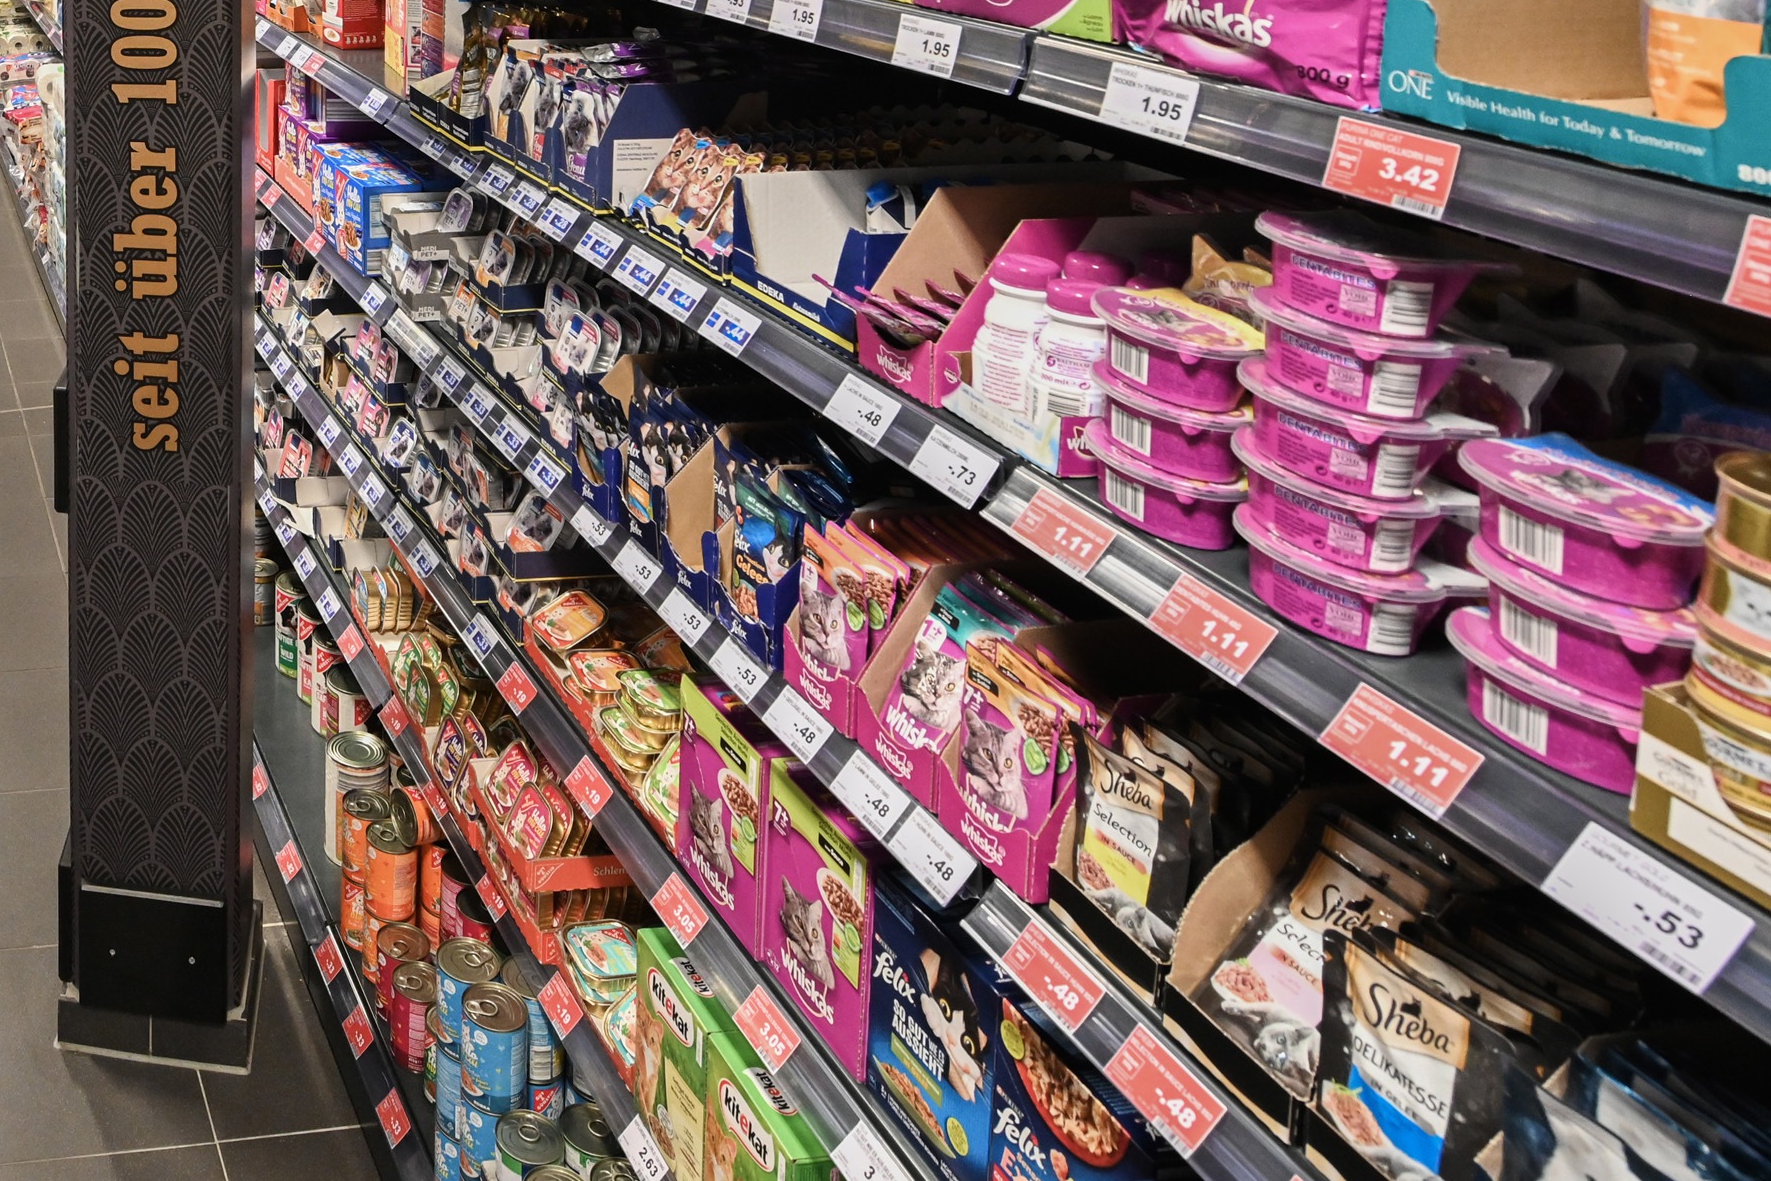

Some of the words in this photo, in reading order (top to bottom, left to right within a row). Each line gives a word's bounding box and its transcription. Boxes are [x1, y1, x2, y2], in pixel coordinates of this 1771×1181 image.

[792, 7, 815, 25] 1.95
[922, 39, 951, 58] 1.95
[1388, 68, 1433, 100] ONE
[1141, 95, 1183, 121] 1.95
[1447, 89, 1488, 113] Visible
[1490, 99, 1536, 123] Health
[1540, 111, 1560, 128] for
[1563, 116, 1606, 140] Today
[1609, 126, 1622, 141] &
[1625, 129, 1707, 158] Tomorrow
[1378, 156, 1440, 192] 3.42
[113, 140, 179, 299] über
[1291, 252, 1377, 290] DENTABITES
[757, 280, 785, 304] EDEKA
[876, 356, 912, 382] whiskas
[1281, 331, 1364, 370] DENTABITES
[113, 331, 180, 453] seit
[857, 407, 883, 428] -.48
[948, 461, 977, 486] -.73
[1054, 526, 1092, 558] 1.11
[1200, 619, 1249, 659] 1.11
[736, 665, 758, 687] -.53
[793, 720, 817, 745] -.48
[1389, 740, 1450, 788] 1.11
[865, 791, 890, 818] -.48
[1100, 759, 1153, 811] Sheba
[961, 815, 1005, 866] whiskas
[1093, 803, 1153, 858] Selection
[690, 846, 736, 911] whiskas
[926, 853, 954, 881] -.48
[673, 904, 695, 934] 3.05
[1631, 899, 1707, 952] -.53
[781, 946, 835, 1025] whiskas
[873, 950, 916, 1006] felix
[1043, 974, 1079, 1011] -.48
[651, 973, 690, 1040] kitekat
[893, 1000, 906, 1023] SO
[908, 1016, 929, 1046] GUT
[1364, 982, 1451, 1054] Sheba
[759, 1022, 786, 1057] 3.05
[892, 1013, 945, 1082] AUSSIEHT
[1353, 1035, 1448, 1119] DELIKATESSE
[723, 1086, 770, 1165] kitekat
[1155, 1088, 1198, 1130] -.48
[993, 1107, 1047, 1169] felix
[638, 1146, 659, 1177] 2.63
